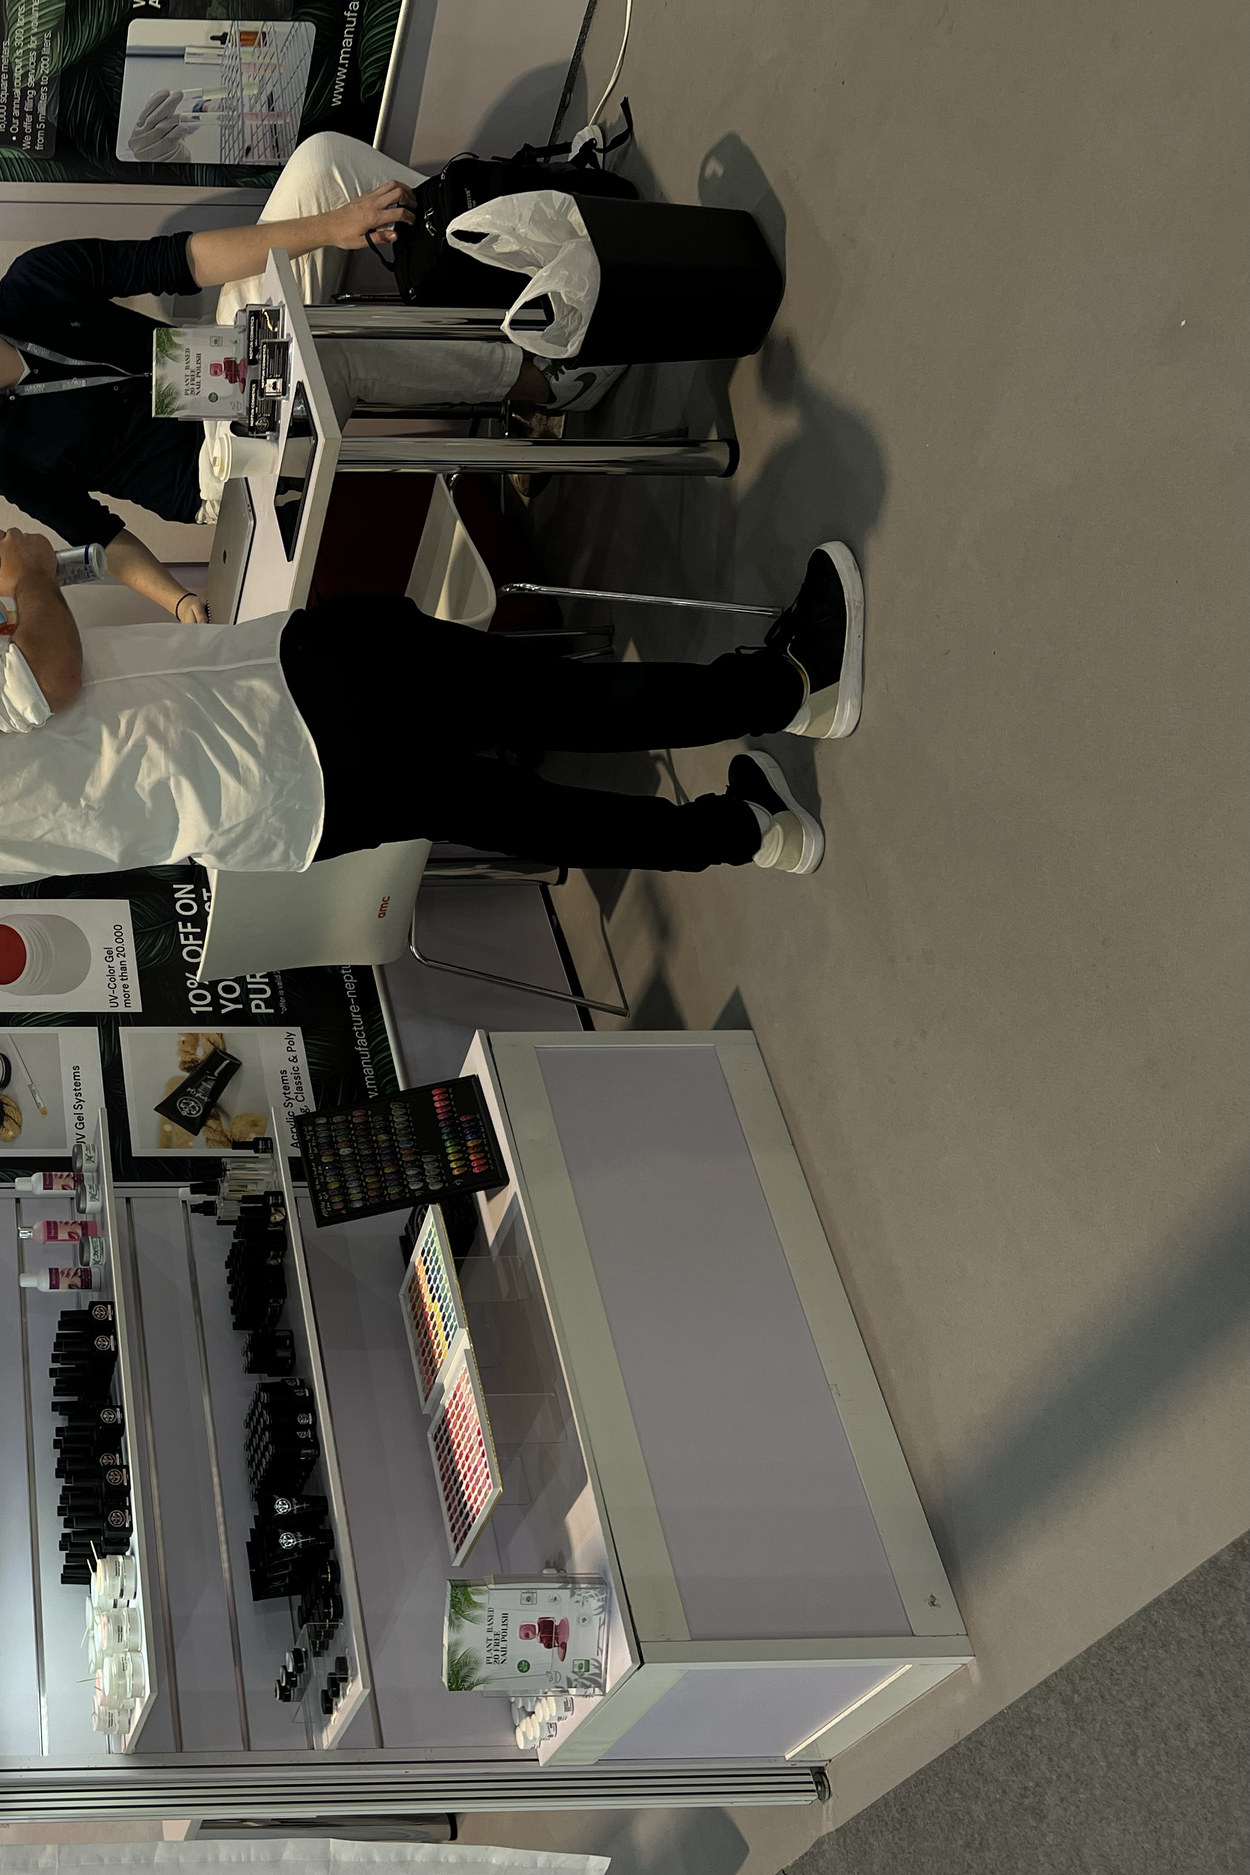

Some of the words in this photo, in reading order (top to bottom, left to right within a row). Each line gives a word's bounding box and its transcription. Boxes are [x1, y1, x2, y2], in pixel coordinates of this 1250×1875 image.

[14, 29, 24, 47] 300
[28, 35, 38, 48] for
[330, 0, 360, 106] www.manufa
[14, 58, 23, 87] output
[26, 51, 37, 88] services
[40, 56, 50, 74] 200
[39, 76, 48, 85] to
[12, 88, 21, 116] annual
[10, 118, 19, 134] Our
[22, 114, 32, 133] offer
[22, 135, 32, 150] We
[35, 130, 44, 150] from
[190, 388, 195, 396] 20
[172, 884, 198, 916] ON
[377, 896, 390, 918] amc
[113, 924, 126, 958] 20.000
[178, 921, 203, 962] OFF
[103, 947, 115, 962] Gel
[119, 960, 129, 981] than
[106, 964, 119, 1008] UV-Color
[122, 984, 132, 1008] more
[284, 1032, 297, 1052] Poly
[288, 1055, 298, 1064] &
[71, 1065, 86, 1110] Systems
[279, 1069, 295, 1108] Sytems
[291, 1066, 306, 1102] Classic
[73, 1112, 86, 1130] Gel
[486, 1607, 494, 1633] BASED
[501, 1612, 509, 1642] POLISH
[485, 1637, 493, 1665] PLANT
[493, 1631, 501, 1652] FREE
[493, 1654, 500, 1665] 20
[500, 1644, 508, 1664] NAIL
